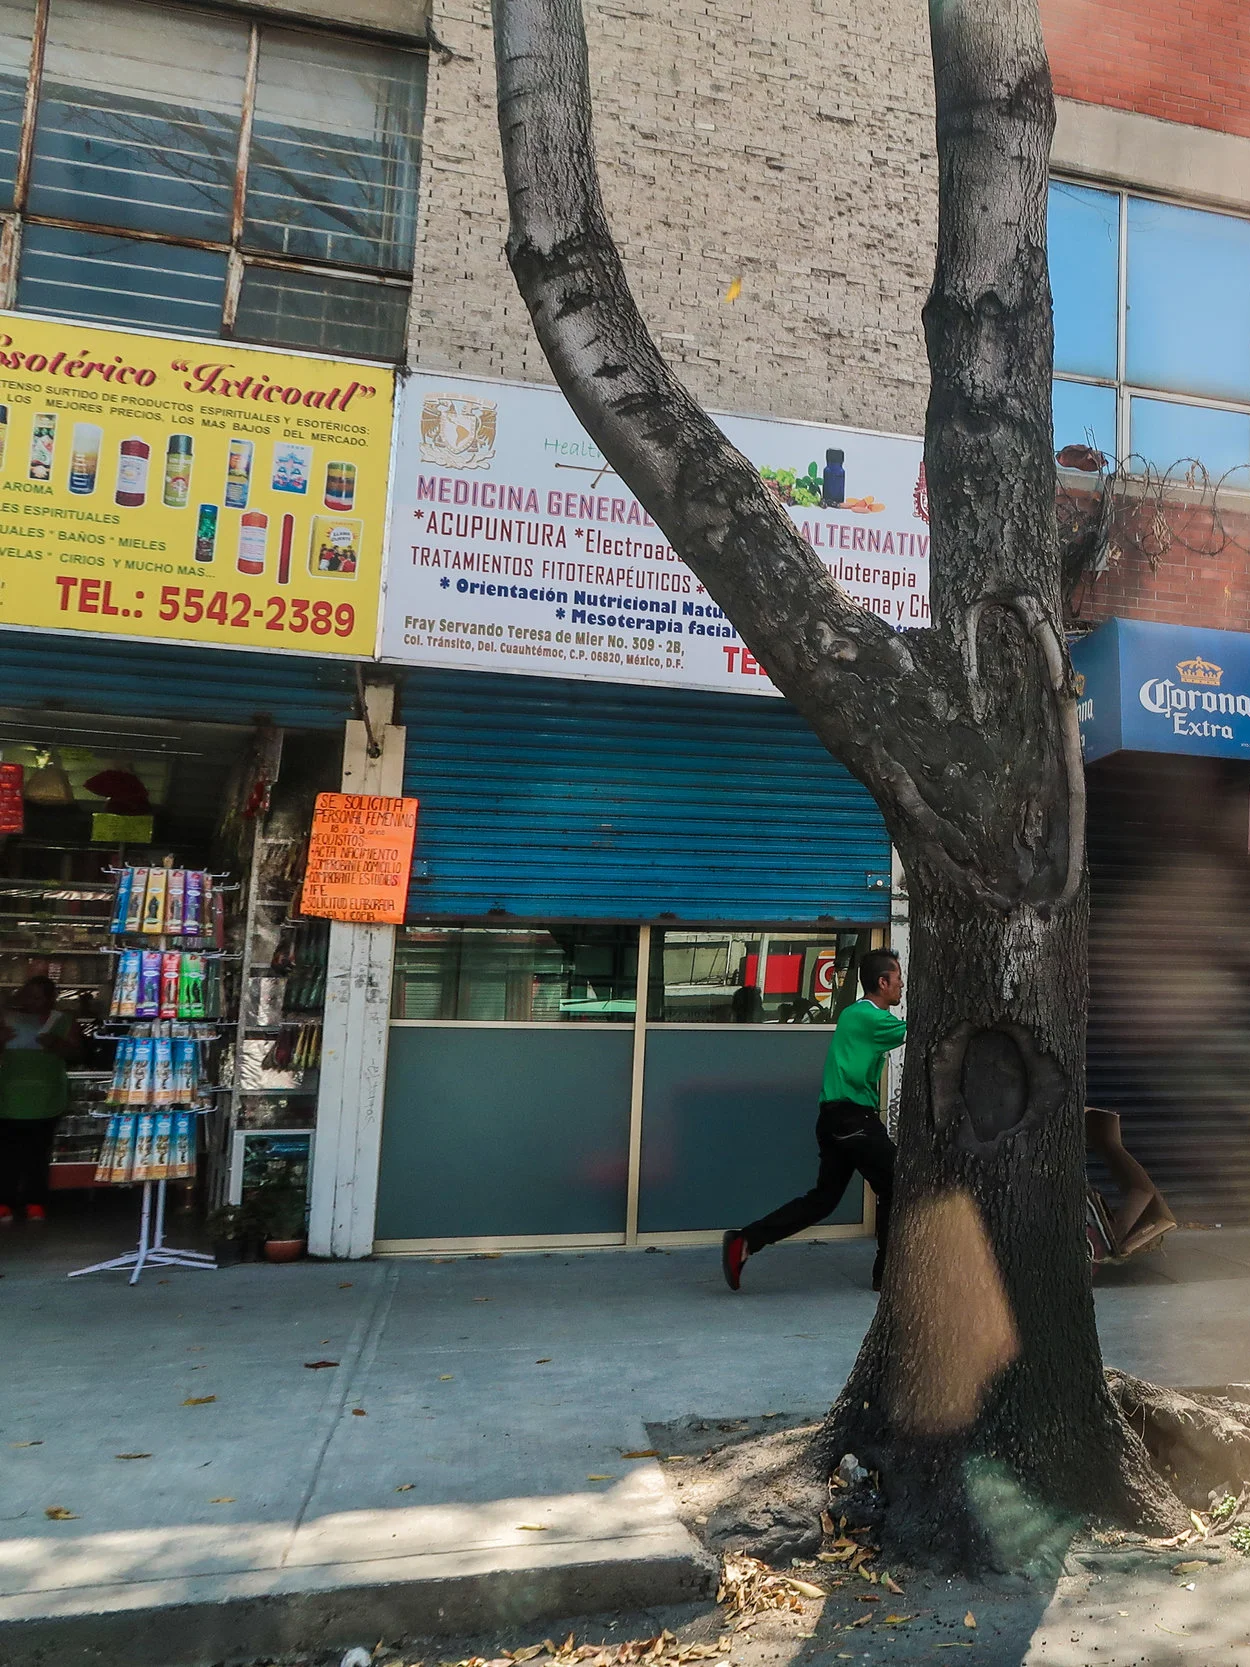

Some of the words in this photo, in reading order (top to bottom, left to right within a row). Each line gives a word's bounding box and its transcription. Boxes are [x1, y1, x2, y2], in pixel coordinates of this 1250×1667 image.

[7, 394, 32, 404] LOS
[46, 398, 103, 414] MEJORES
[171, 415, 195, 426] LOS
[201, 418, 226, 429] MAS
[232, 422, 271, 435] BAJOS
[283, 428, 305, 440] DEL
[46, 385, 99, 401] SURTIDO
[102, 392, 118, 404] DE
[121, 395, 194, 412] PRODUCTOS
[200, 406, 281, 424] ESPIRITUALES
[284, 416, 292, 426] Y
[544, 438, 602, 458] Healt
[3, 481, 54, 496] AROMA
[416, 474, 540, 514] MEDICINA
[24, 505, 121, 524] ESPIRITUALES
[58, 530, 106, 545] BAÑOS
[118, 536, 167, 551] MIELES
[59, 553, 105, 567] CIRIOS
[113, 558, 122, 569] Y
[125, 560, 174, 575] MUCHO
[411, 546, 534, 577] TRATAMIENTOS
[543, 560, 692, 594] FITOTERAPÉUTICOS
[897, 600, 905, 620] y
[457, 578, 568, 604] Orientación
[574, 590, 677, 615] Nutricional
[56, 575, 145, 618] TEL.:
[159, 586, 356, 637] 5542-2389
[404, 615, 436, 633] Fray
[439, 618, 504, 637] Servando
[508, 625, 552, 642] Teresa
[556, 630, 572, 643] de
[575, 631, 605, 646] Mier
[607, 635, 628, 649] No.
[632, 637, 655, 651] 309
[666, 640, 685, 656] 2B,
[572, 609, 683, 634] Mesoterapia
[688, 620, 737, 639] facial
[404, 634, 424, 646] Col.
[427, 635, 475, 652] Tránsito,
[478, 640, 498, 653] Del.
[500, 642, 567, 660] Cuauhtémoc,
[569, 649, 588, 662] C.P.
[590, 651, 623, 665] 06820,
[626, 655, 664, 669] México,
[666, 657, 684, 670] D.F.
[1173, 712, 1234, 739] Extra
[320, 794, 337, 809] SE
[344, 795, 404, 812] SOLICITA
[314, 808, 363, 825] PERSONAL
[365, 811, 415, 828] FEMENINO
[340, 847, 399, 861] NACIMIENTO
